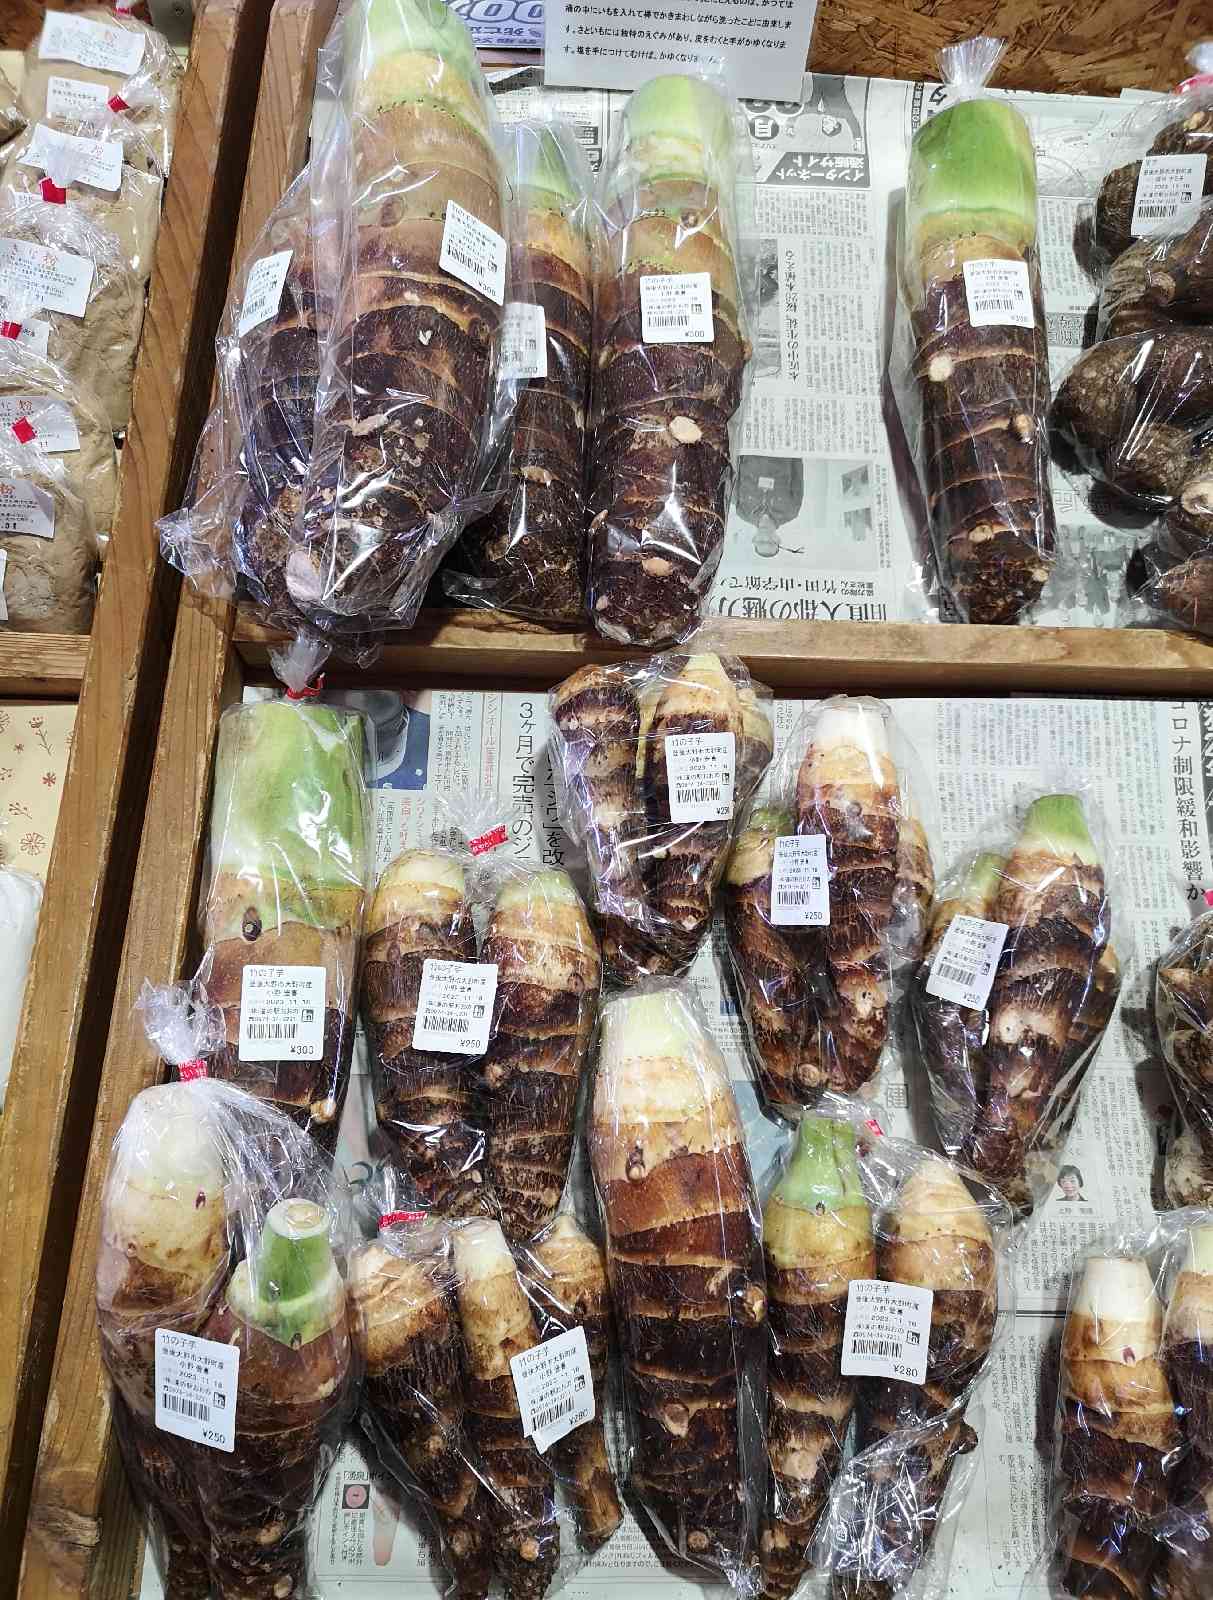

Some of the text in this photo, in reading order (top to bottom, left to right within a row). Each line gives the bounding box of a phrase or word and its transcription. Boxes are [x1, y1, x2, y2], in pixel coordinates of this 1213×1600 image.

[792, 156, 865, 170] 通販サイト
[775, 168, 865, 182] インターネット
[704, 596, 887, 621] 旧直入郡の魅力
[511, 702, 537, 860] 3ヶ月で完売のジ
[804, 911, 822, 919] ¥250
[290, 1045, 313, 1054] ¥300
[460, 1038, 481, 1048] ¥250
[892, 1365, 917, 1377] ¥280
[202, 1427, 225, 1444] ¥250
